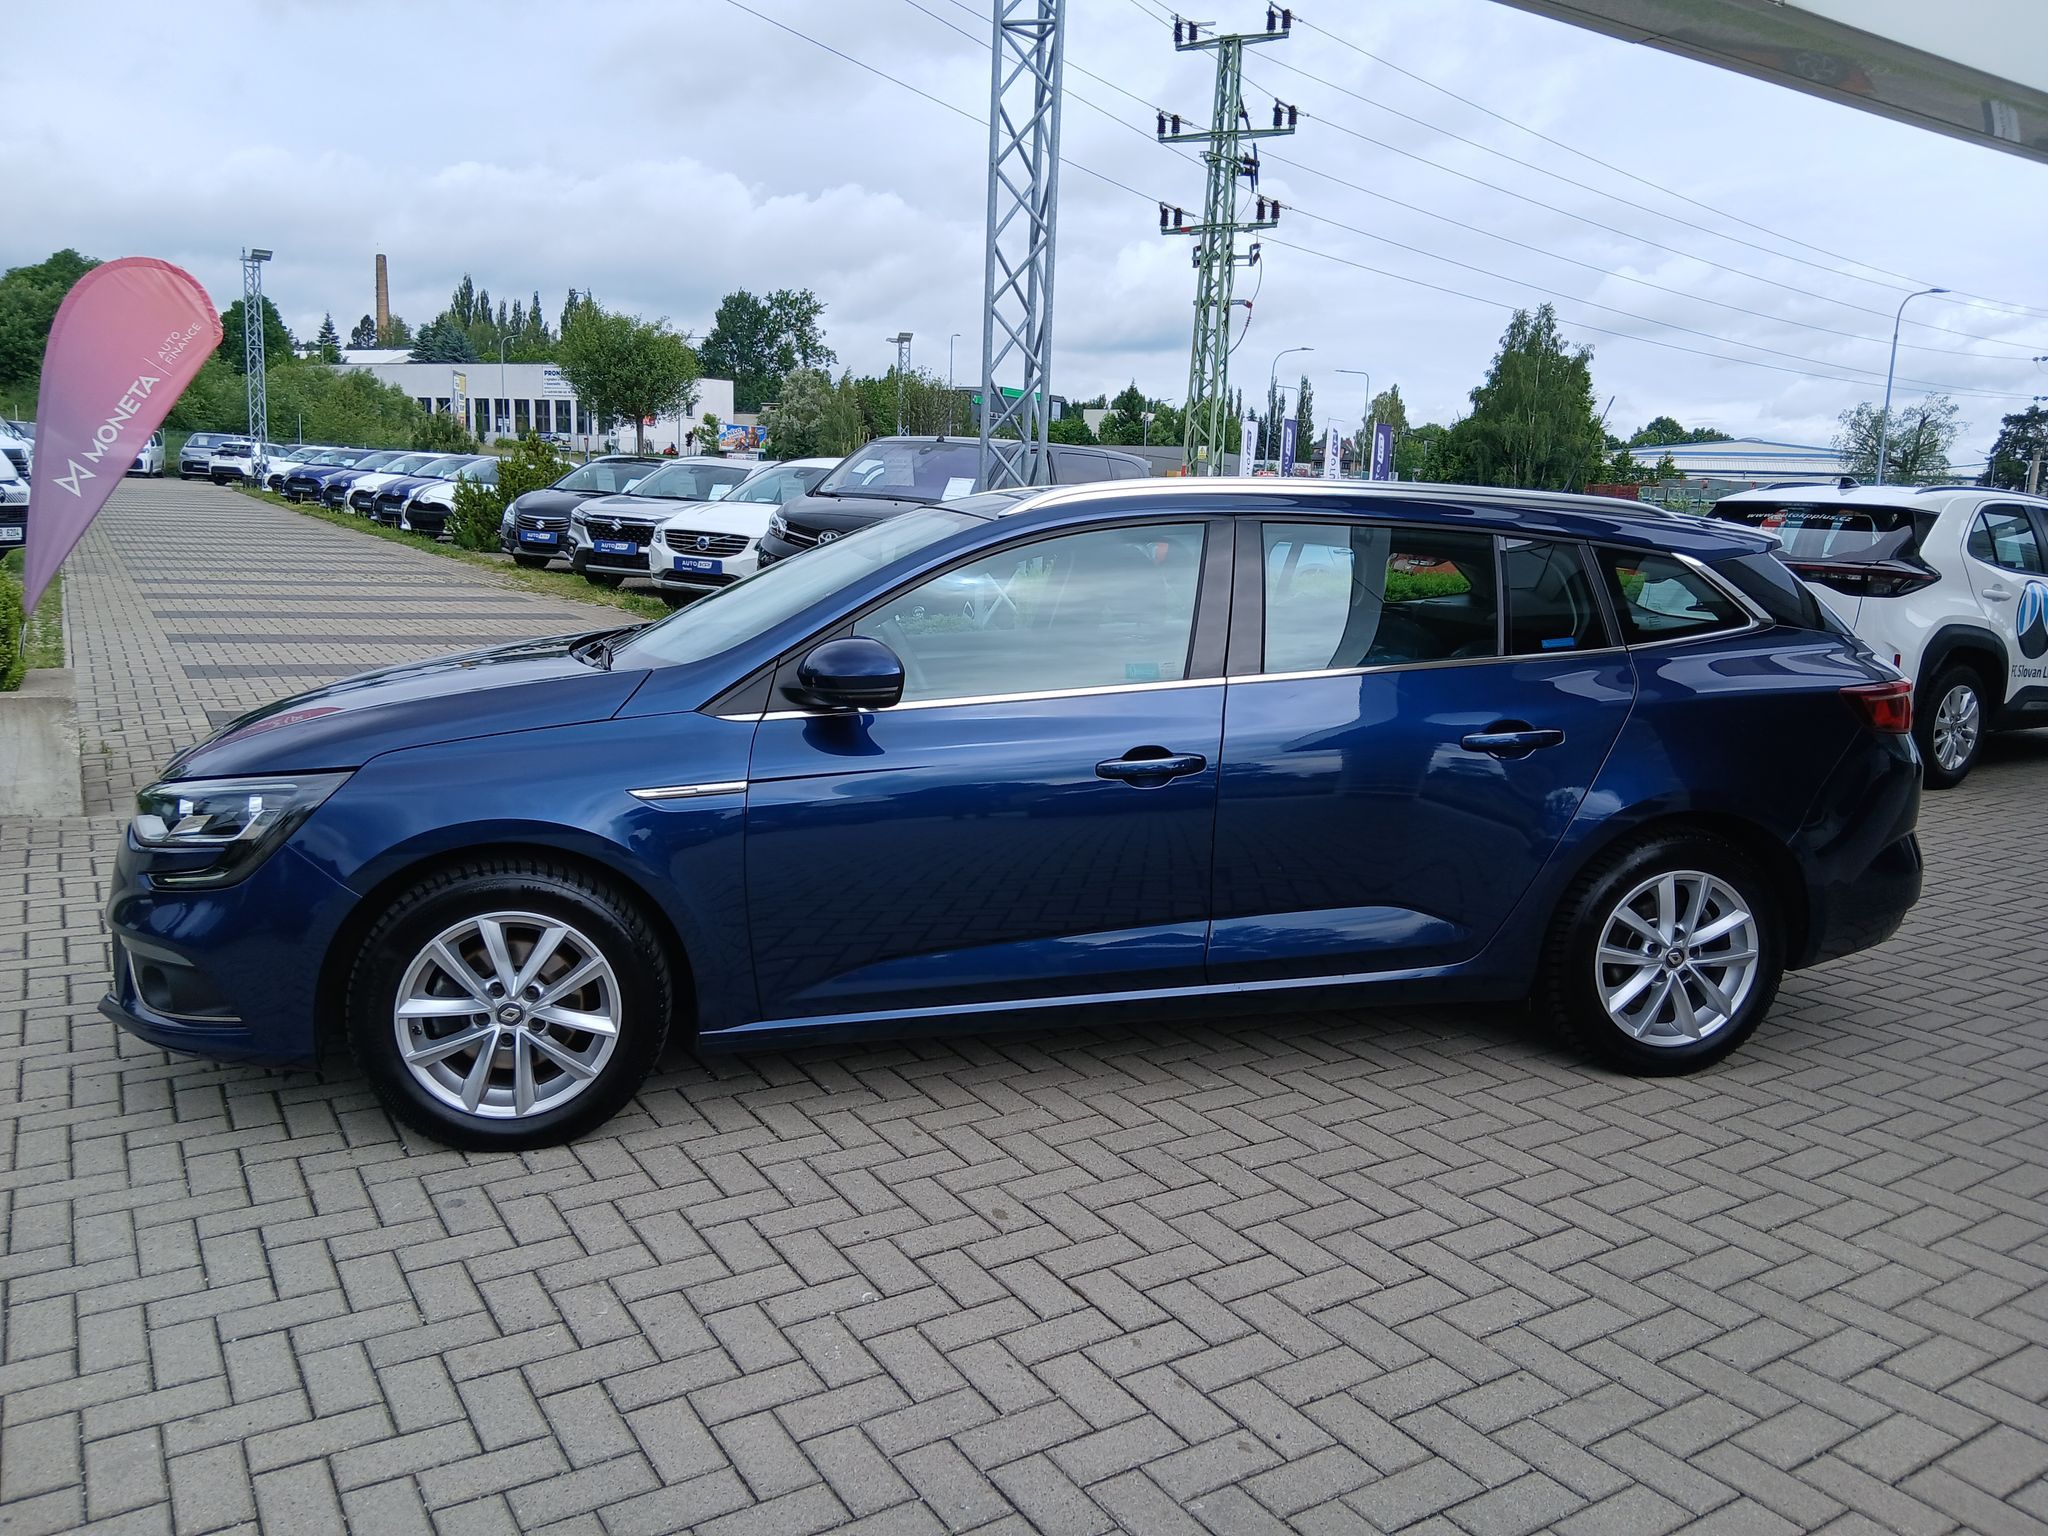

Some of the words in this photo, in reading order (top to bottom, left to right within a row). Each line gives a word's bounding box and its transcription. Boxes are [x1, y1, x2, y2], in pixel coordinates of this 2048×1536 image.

[157, 331, 181, 359] AUTO
[164, 322, 202, 366] FINANCE
[81, 375, 161, 464] MONETA
[2017, 664, 2042, 678] Slovan
